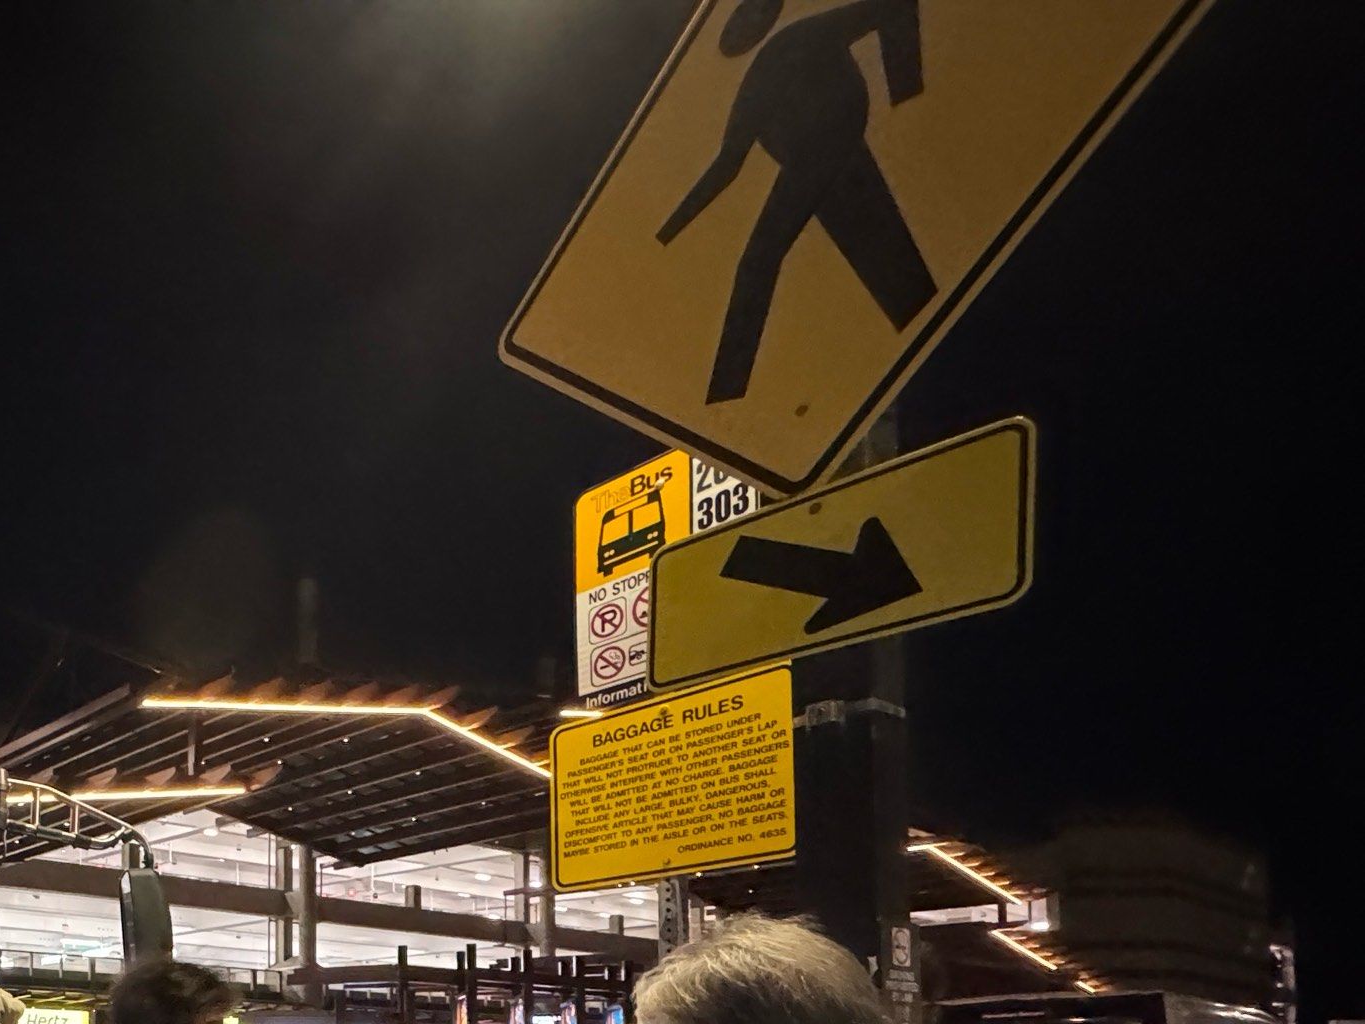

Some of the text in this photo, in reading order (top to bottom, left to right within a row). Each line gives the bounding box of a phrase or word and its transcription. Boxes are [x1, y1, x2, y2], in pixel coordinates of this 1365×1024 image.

[697, 484, 749, 530] 303
[589, 588, 606, 604] NO
[580, 713, 761, 766] BAGGAGE THAT CAN BE STORED UNDER
[592, 695, 743, 748] BAGGAGE RULES
[561, 740, 789, 799] OTHERWISE INTERFERE WITH OTHER PASSENGERS
[563, 729, 786, 789] THAT WILL NOT PROTRUDE TO ANOTHER SEAT OR
[567, 720, 777, 778] PASSENGER'S SEAT OR ON PASSENGER'S LAP
[569, 798, 588, 807] WILL
[592, 794, 602, 803] BE
[606, 784, 648, 799] ADMITTED
[652, 780, 661, 790] AT
[666, 776, 679, 786] NO
[729, 754, 777, 772] BAGGAGE
[571, 768, 776, 817] THAT WILL NOT BE ADMITTED ON BUS SHALL
[564, 833, 617, 848] DISCOMFORT
[622, 830, 632, 838] TO
[636, 826, 652, 836] ANY
[719, 811, 733, 820] NO
[738, 799, 787, 814] BAGGAGE
[565, 788, 784, 839] OFFENSIVE ARTICLE THAT MAY CAUSE HARM OR
[575, 813, 610, 826] INCLUDE
[614, 809, 631, 819] ANY
[594, 841, 626, 853] STORED
[630, 838, 639, 846] IN
[643, 834, 659, 843] THE
[663, 828, 689, 840] AISLE
[693, 826, 706, 835] OR
[710, 823, 724, 832] ON
[729, 818, 747, 828] THE
[678, 828, 787, 853] ORDINANCE NO. 4635
